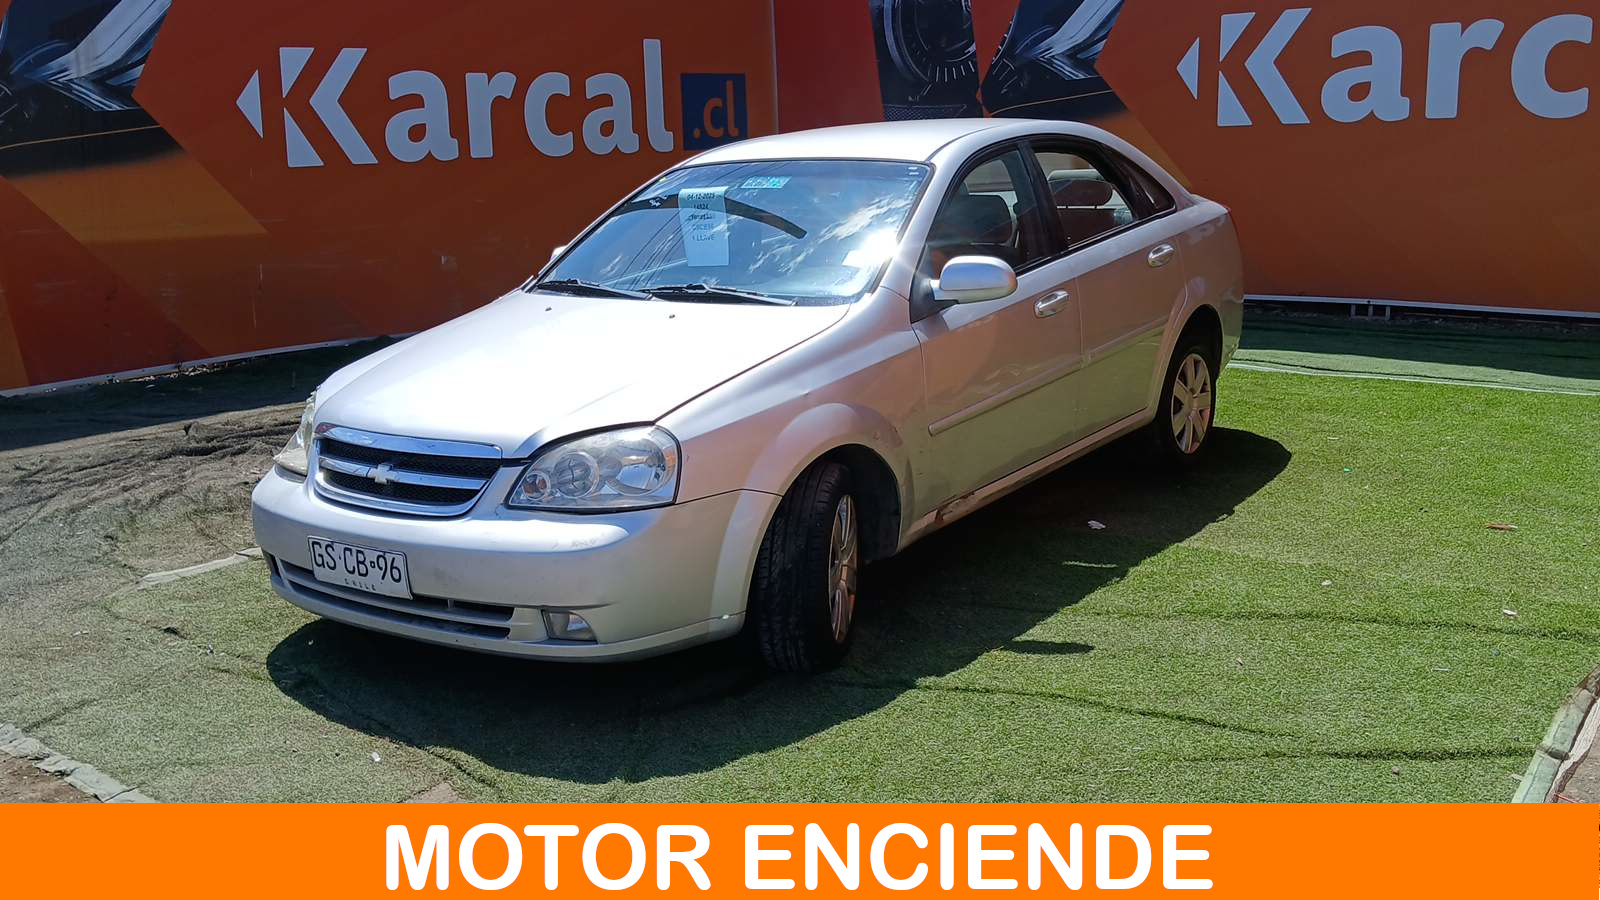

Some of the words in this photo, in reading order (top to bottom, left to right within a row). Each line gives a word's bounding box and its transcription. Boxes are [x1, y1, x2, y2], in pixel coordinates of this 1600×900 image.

[279, 38, 674, 168] Karcal
[693, 80, 740, 139] .cl
[1216, 7, 1593, 127] Karc
